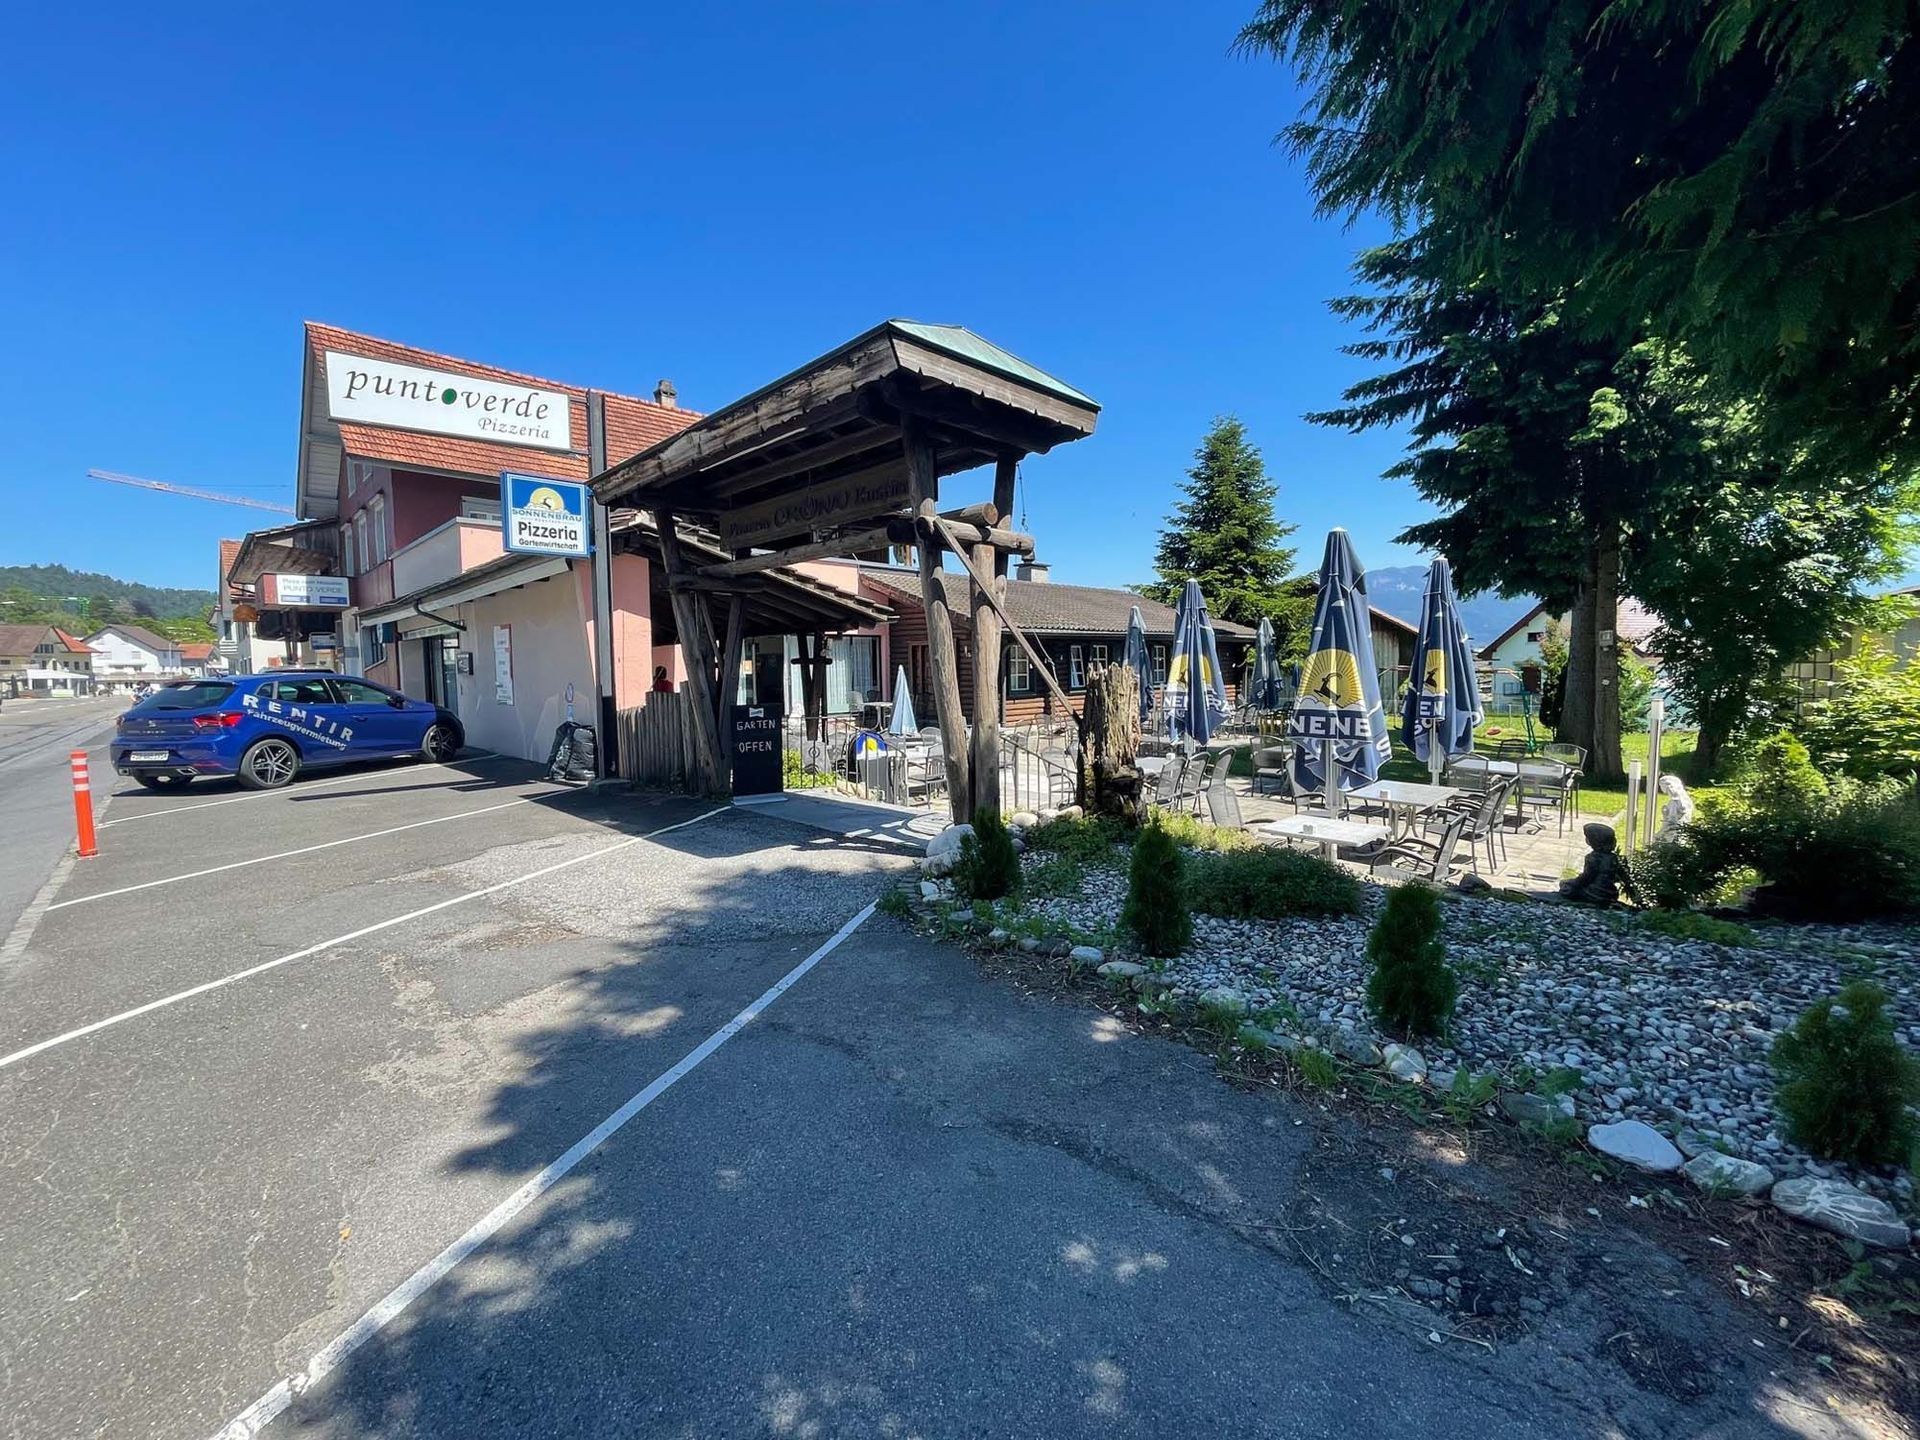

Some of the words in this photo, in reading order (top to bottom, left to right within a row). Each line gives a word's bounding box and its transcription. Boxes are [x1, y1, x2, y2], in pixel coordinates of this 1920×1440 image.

[478, 417, 549, 439] Pizzeria
[518, 521, 577, 540] Pizzeria
[518, 538, 578, 550] Gartenwirtschaft
[243, 694, 353, 741] RENTIR
[736, 719, 776, 731] GARTEN
[247, 709, 348, 751] Fahrzeugvermietung
[738, 741, 772, 754] OFFEN
